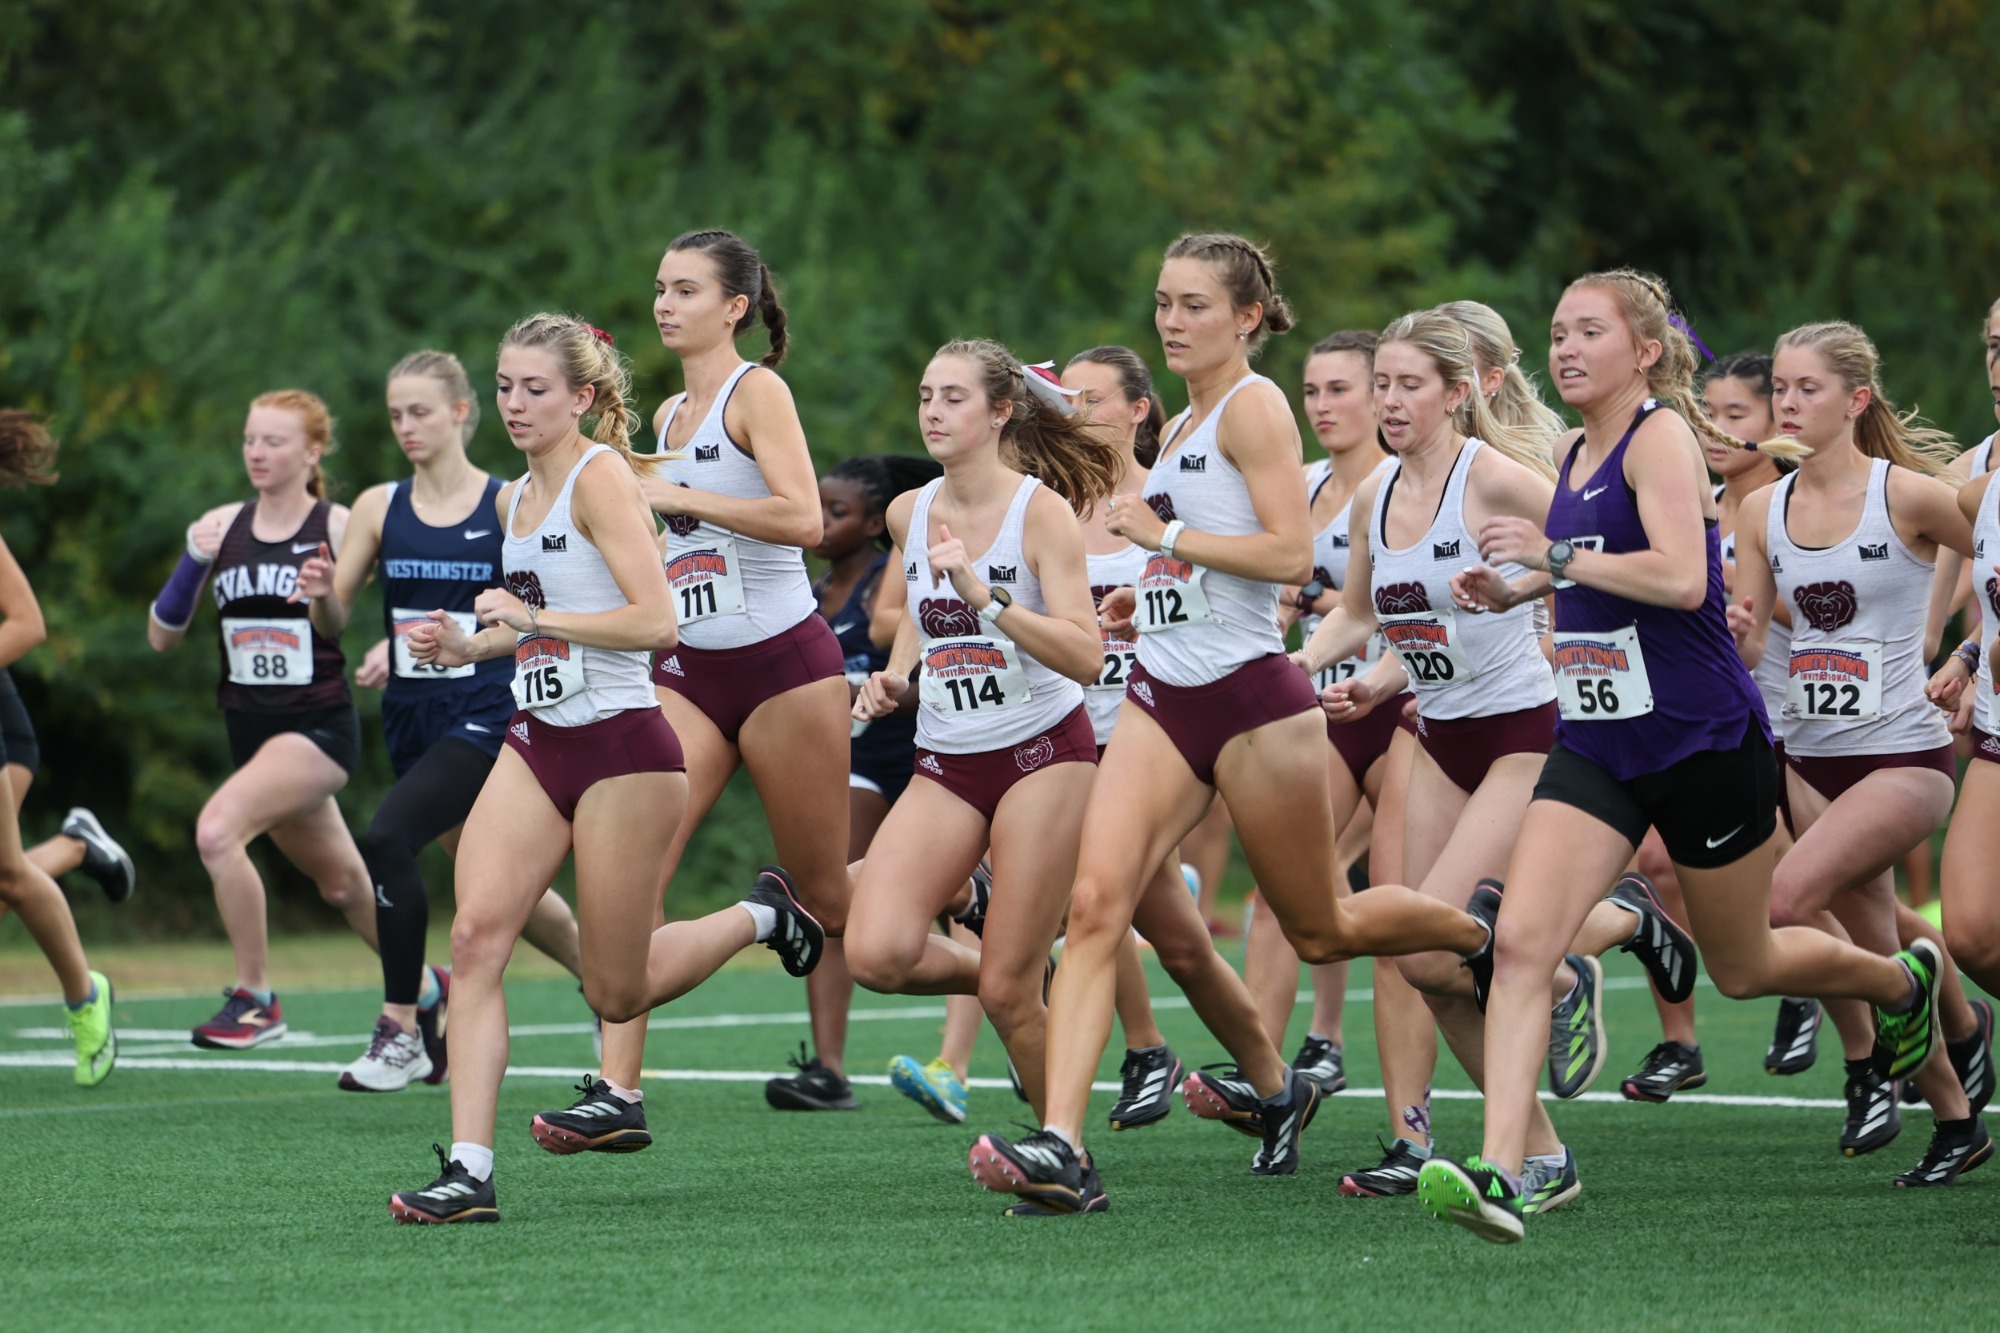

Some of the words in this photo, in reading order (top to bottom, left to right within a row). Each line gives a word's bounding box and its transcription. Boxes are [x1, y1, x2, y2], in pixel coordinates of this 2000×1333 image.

[214, 563, 311, 610] EVANG
[680, 581, 717, 618] 111
[1145, 588, 1189, 625] 112
[253, 654, 288, 678] 88
[661, 663, 685, 677] adidas
[937, 666, 992, 678] INVITATIONAL
[1403, 651, 1454, 680] 120
[1800, 672, 1852, 682] INVITATIONAL
[524, 665, 563, 703] 115
[944, 675, 1006, 711] 114
[1576, 679, 1619, 714] 56
[1803, 683, 1860, 716] 122
[511, 726, 530, 746] adidas
